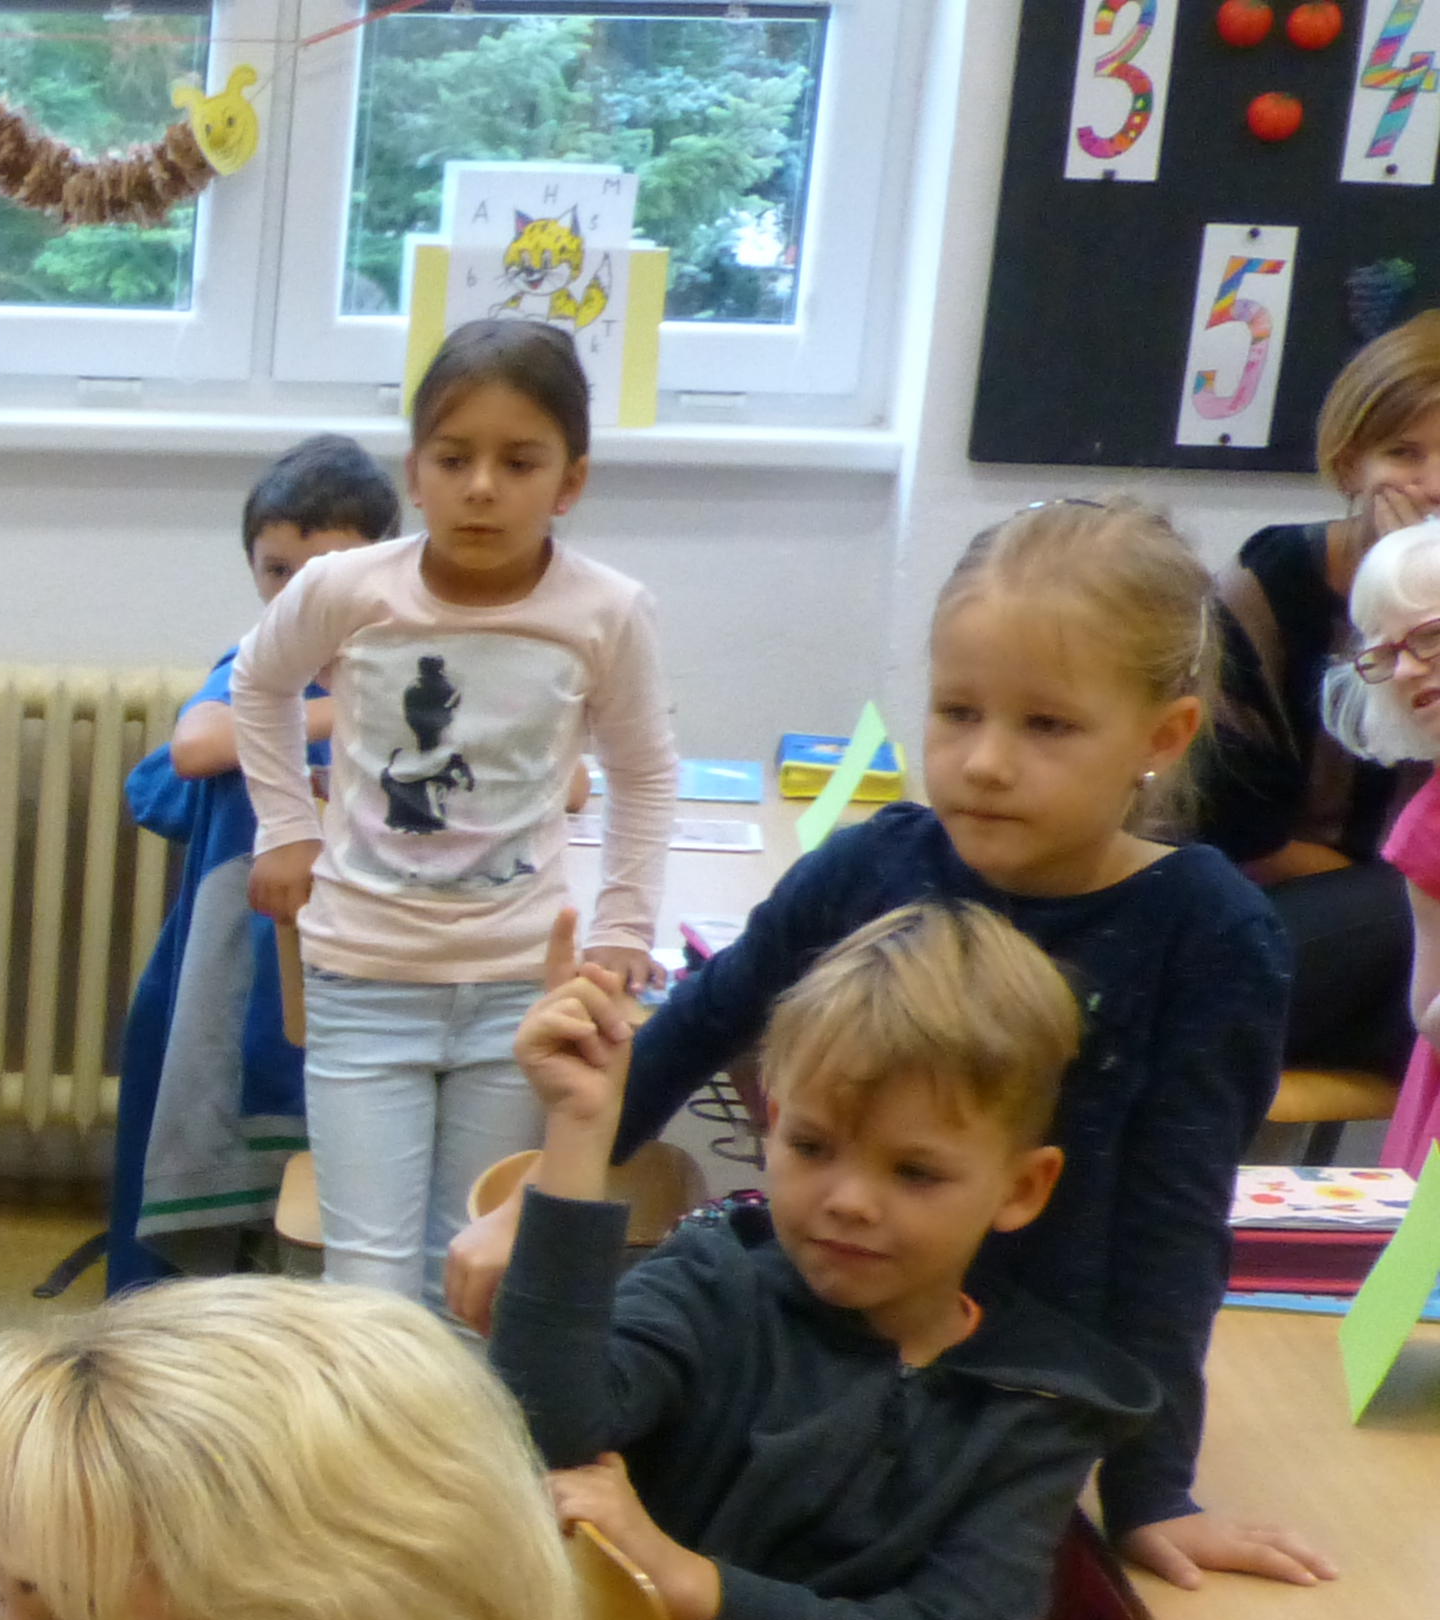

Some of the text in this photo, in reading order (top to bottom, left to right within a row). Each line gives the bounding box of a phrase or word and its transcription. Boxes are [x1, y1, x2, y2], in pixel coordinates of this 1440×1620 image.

[1077, 0, 1158, 159] 3
[1361, 0, 1440, 158] 4
[471, 200, 489, 224] A
[1191, 255, 1287, 420] 5
